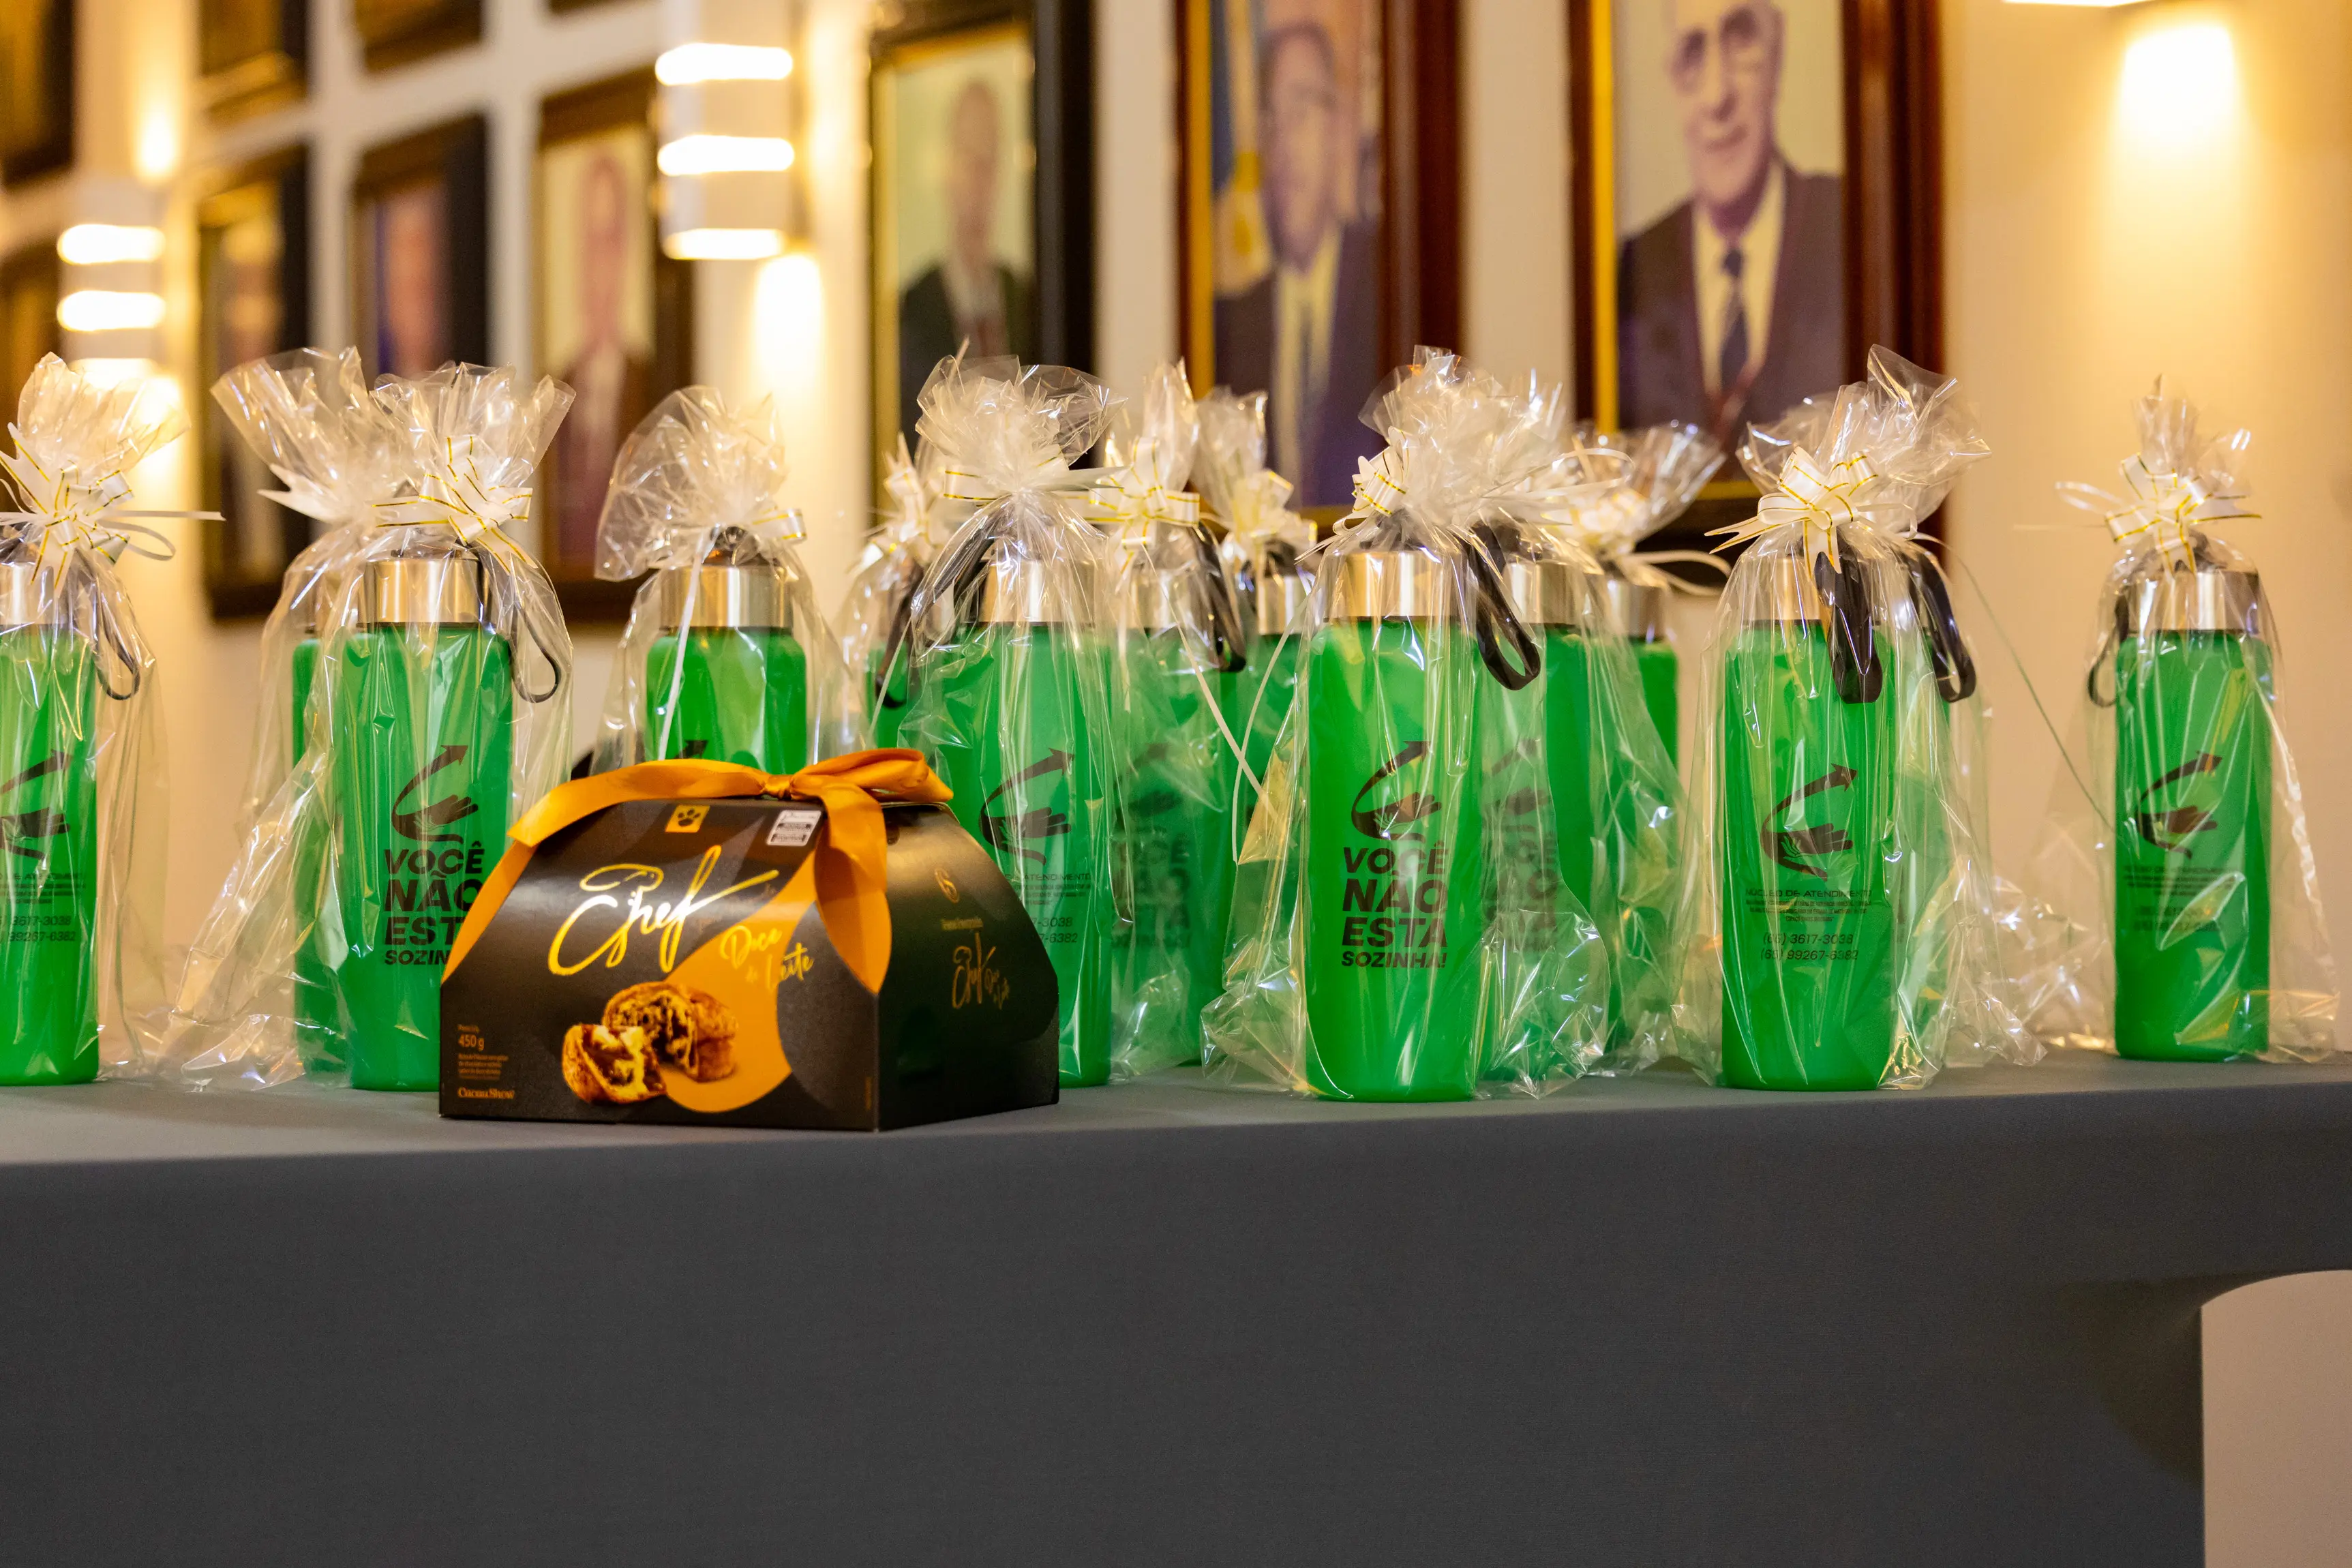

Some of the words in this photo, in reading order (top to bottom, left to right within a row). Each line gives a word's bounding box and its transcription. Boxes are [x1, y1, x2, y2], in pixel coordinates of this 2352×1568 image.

[384, 841, 485, 875] VOCÊ
[1343, 840, 1449, 874] VOCÊ
[385, 870, 483, 911] NÃO
[1785, 890, 1800, 898] DE
[548, 845, 779, 976] Chef
[385, 916, 468, 945] EST
[1031, 917, 1074, 927] 7-3038
[1038, 933, 1079, 943] 7-6382
[1790, 934, 1854, 944] 3617-3038
[385, 950, 451, 965] SOZIN
[1341, 950, 1447, 969] SOZINHA!
[458, 1034, 477, 1048] 450
